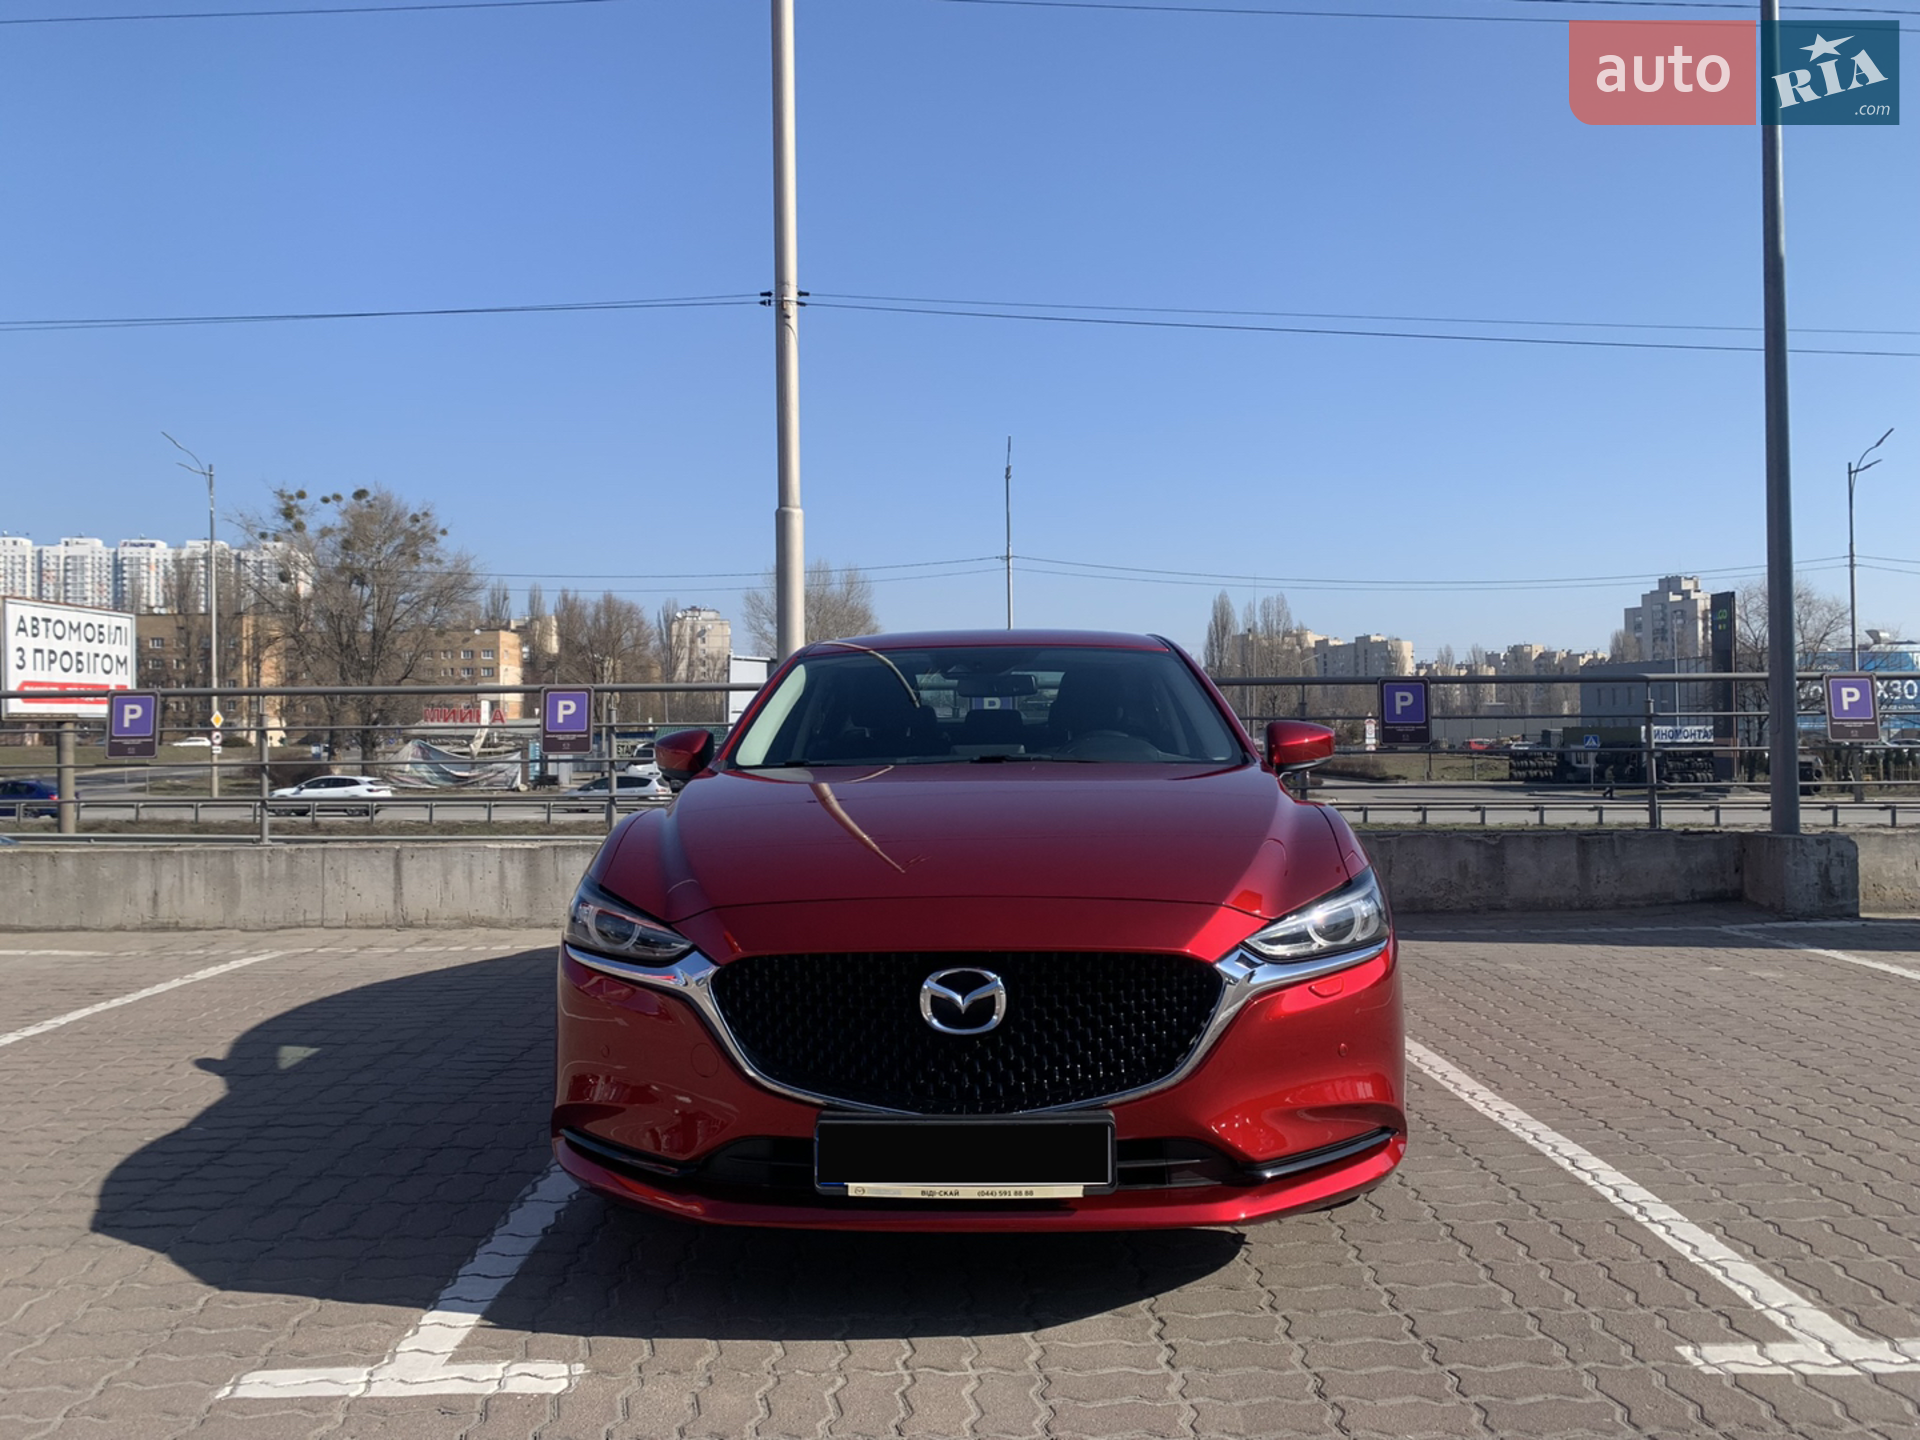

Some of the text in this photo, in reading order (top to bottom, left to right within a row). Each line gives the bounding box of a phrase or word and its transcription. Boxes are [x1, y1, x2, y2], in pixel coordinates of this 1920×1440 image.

[15, 615, 128, 646] АВТОМОБІЛІ
[32, 648, 128, 676] ПРОБІГОМ
[1395, 691, 1414, 715] P
[1841, 687, 1861, 710] P
[123, 704, 143, 728] P
[557, 700, 577, 724] P
[1653, 728, 1714, 740] ИНОМОНТА
[977, 1189, 997, 1197] (044)
